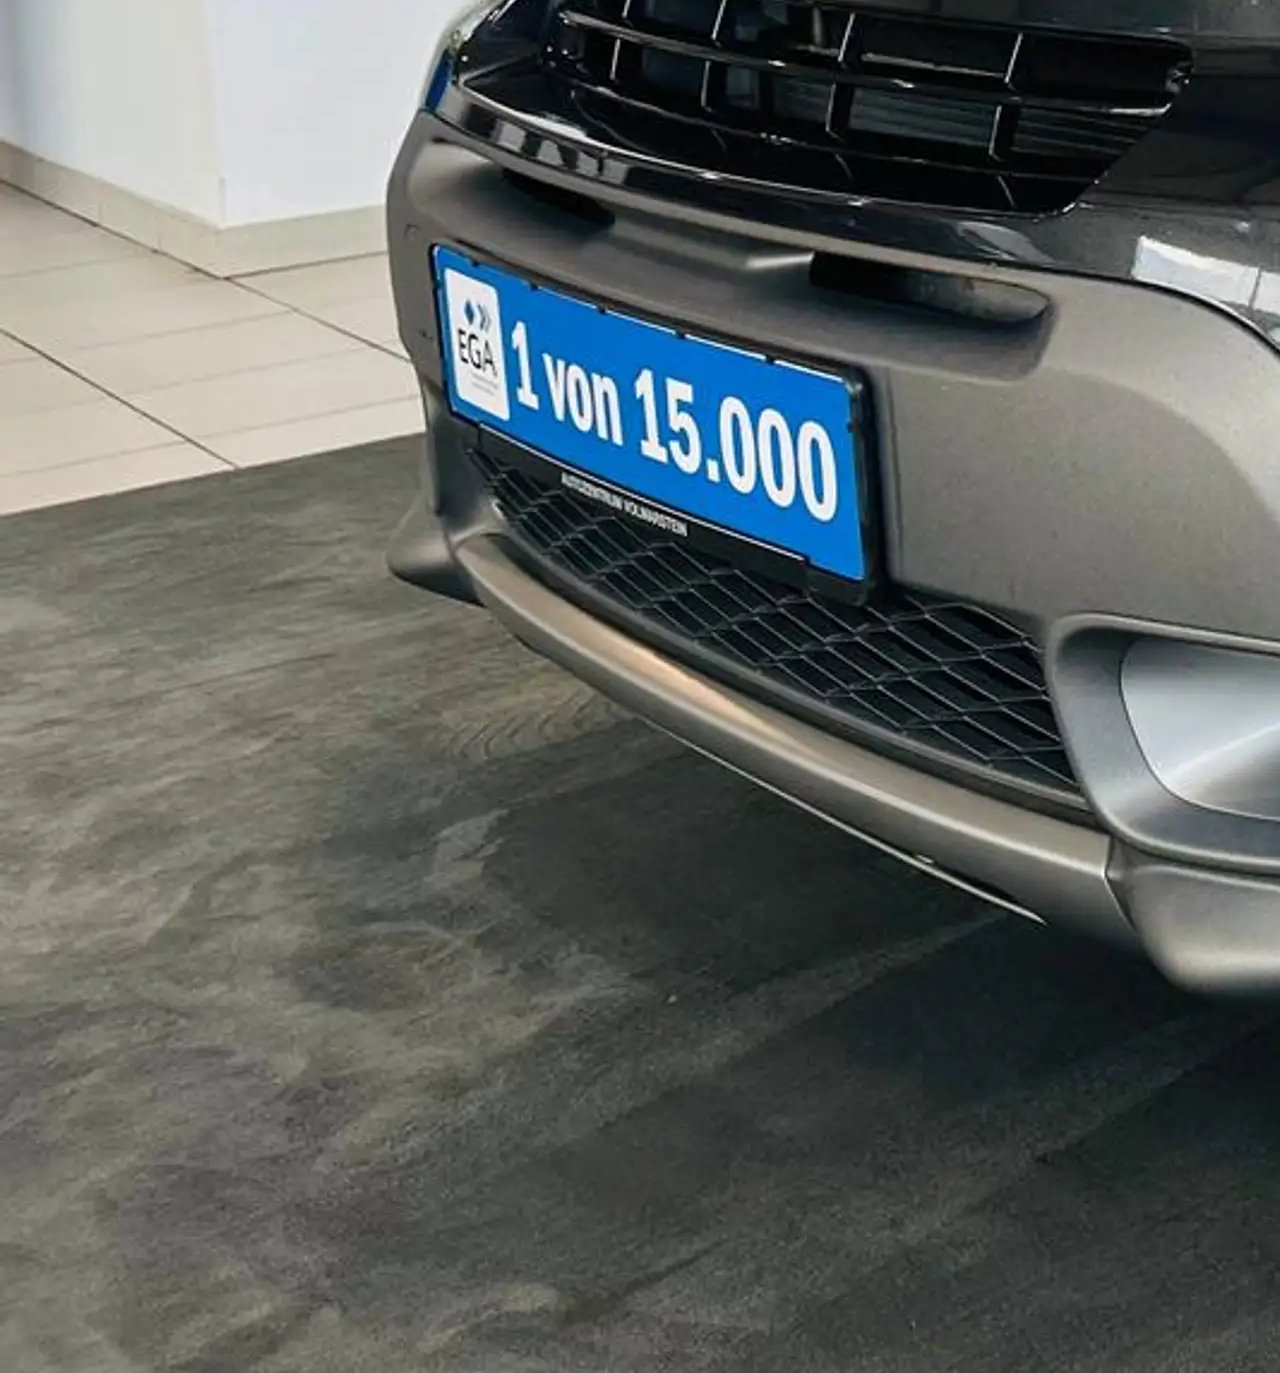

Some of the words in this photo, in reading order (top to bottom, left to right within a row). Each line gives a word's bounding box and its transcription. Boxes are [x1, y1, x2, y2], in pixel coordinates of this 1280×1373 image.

[457, 327, 499, 377] EGA
[510, 320, 540, 411] 1
[543, 352, 623, 447] von
[634, 368, 838, 524] 15.000
